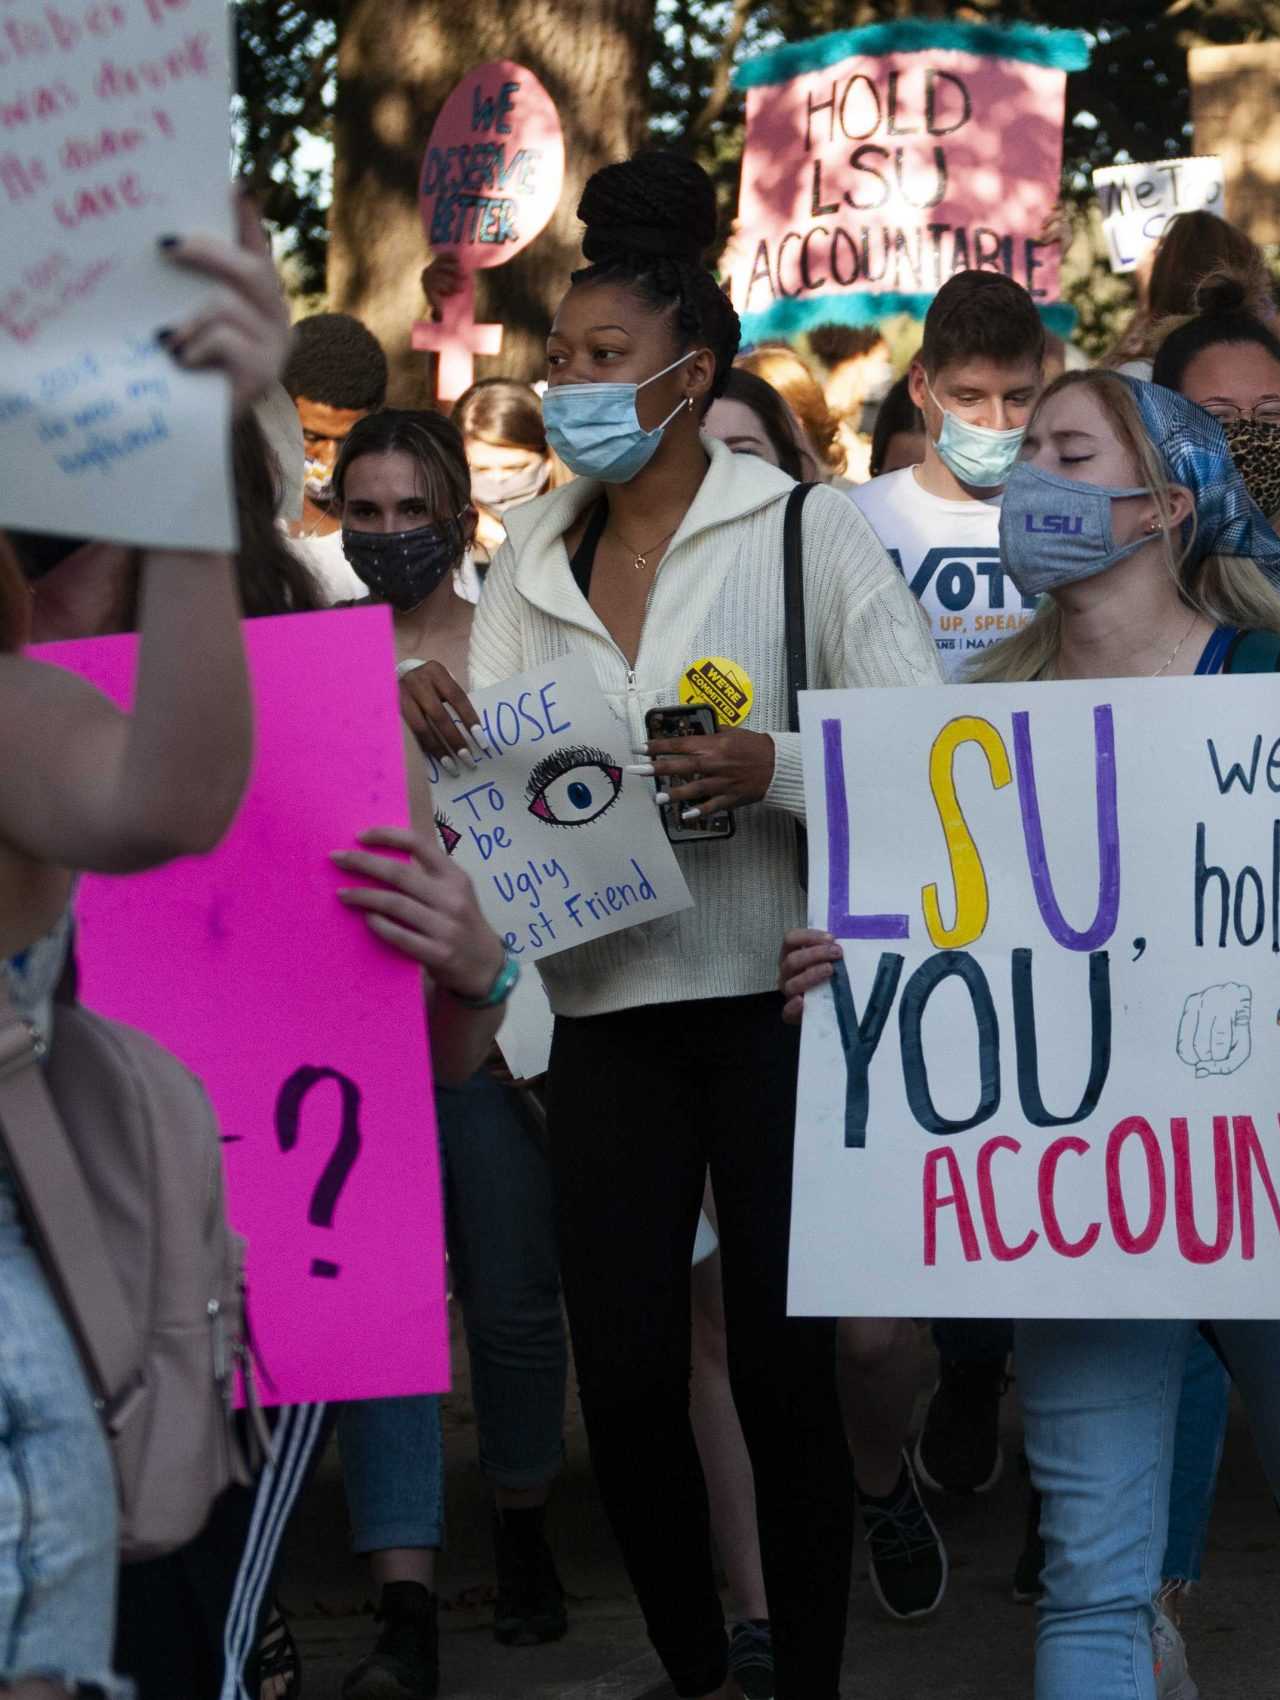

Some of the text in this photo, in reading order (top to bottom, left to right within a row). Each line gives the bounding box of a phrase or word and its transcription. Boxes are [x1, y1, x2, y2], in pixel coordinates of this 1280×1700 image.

[471, 82, 520, 134] WE
[804, 68, 973, 152] HOLD
[423, 142, 544, 195] DESERVE
[811, 143, 949, 217] LSU
[430, 192, 519, 244] BETTER
[745, 222, 1061, 309] ACCOUNTABLE
[1024, 513, 1083, 535] LSU
[886, 547, 1042, 612] VOT
[940, 615, 967, 633] UP,
[691, 673, 736, 718] COMMITTED
[707, 667, 742, 704] WE'RE
[469, 825, 512, 860] be
[493, 858, 570, 909] Ugly
[502, 858, 657, 954] est Friend
[830, 948, 1112, 1149] YOU
